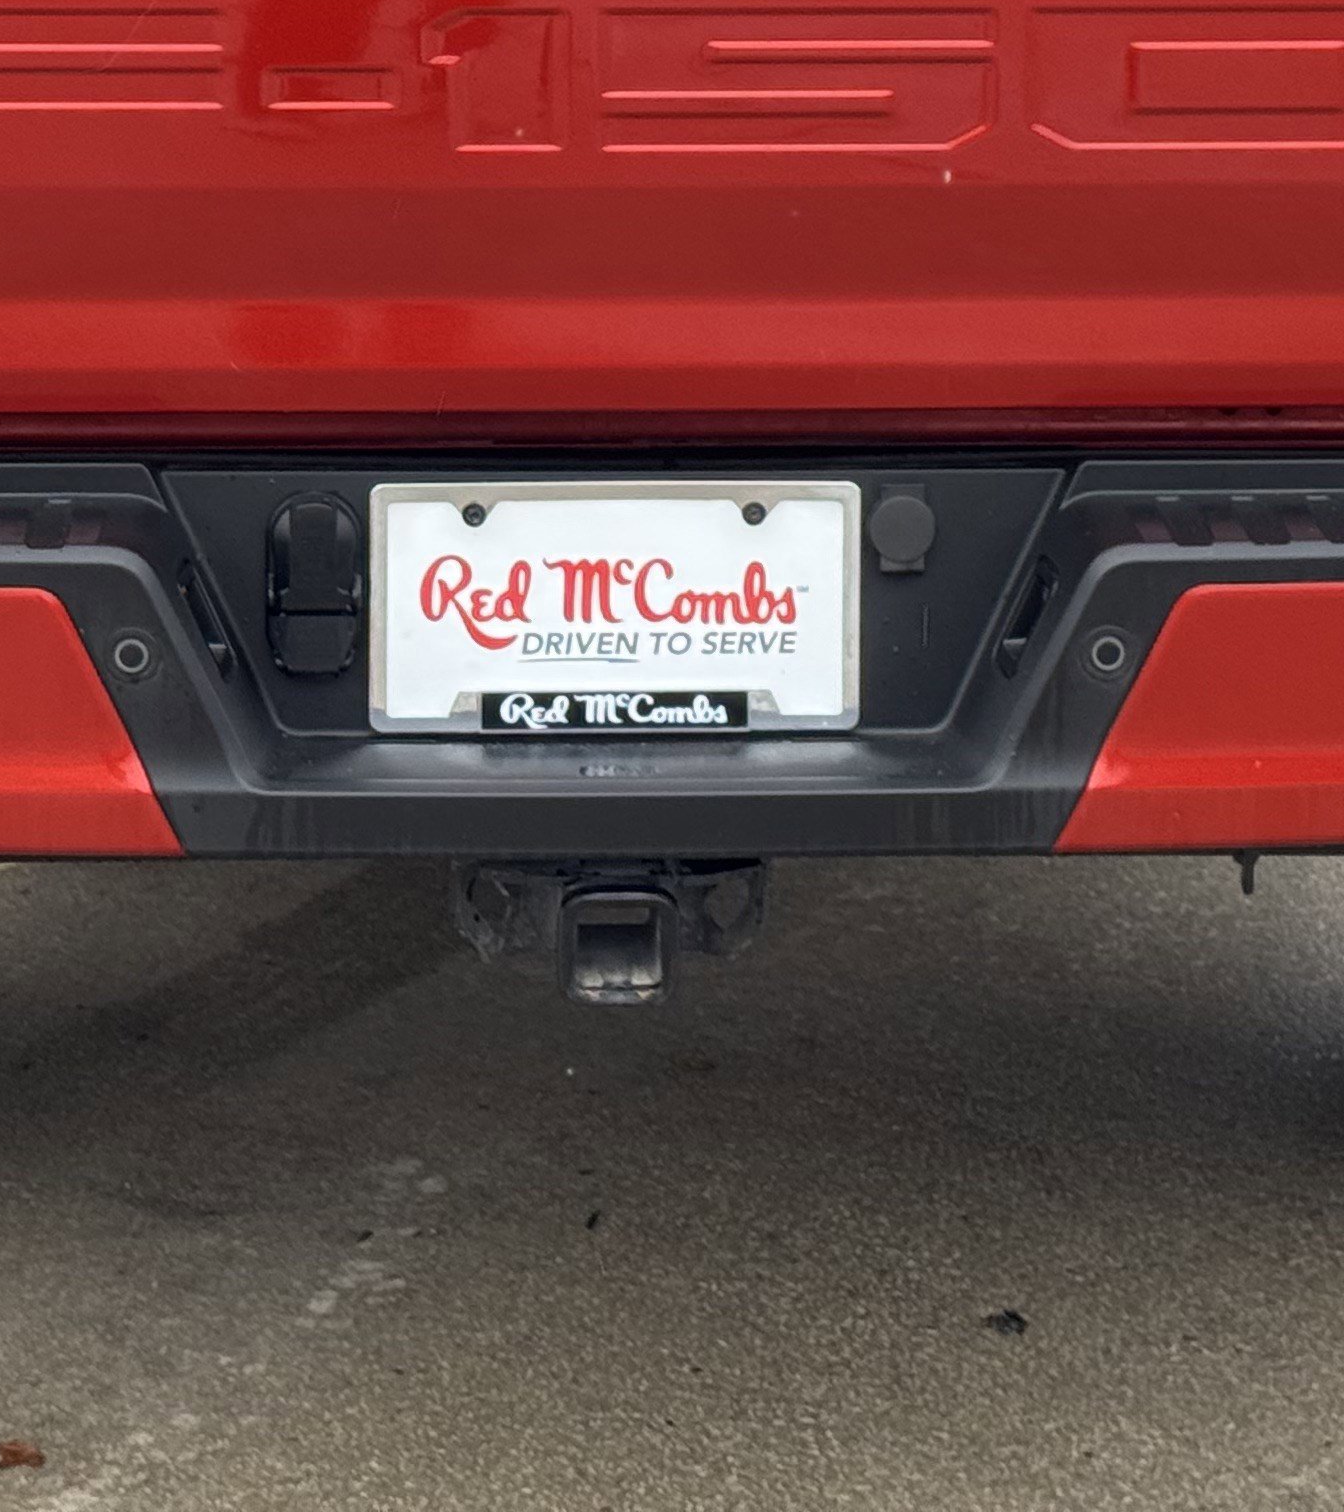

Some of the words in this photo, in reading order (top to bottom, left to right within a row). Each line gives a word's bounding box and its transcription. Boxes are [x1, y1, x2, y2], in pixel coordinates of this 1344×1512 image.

[420, 554, 533, 650] Red
[543, 557, 797, 625] McCombs
[522, 631, 639, 656] DRIVEN
[649, 631, 692, 656] TO
[701, 631, 798, 656] SERVE
[499, 692, 569, 730] Red
[574, 692, 729, 725] McCombs
